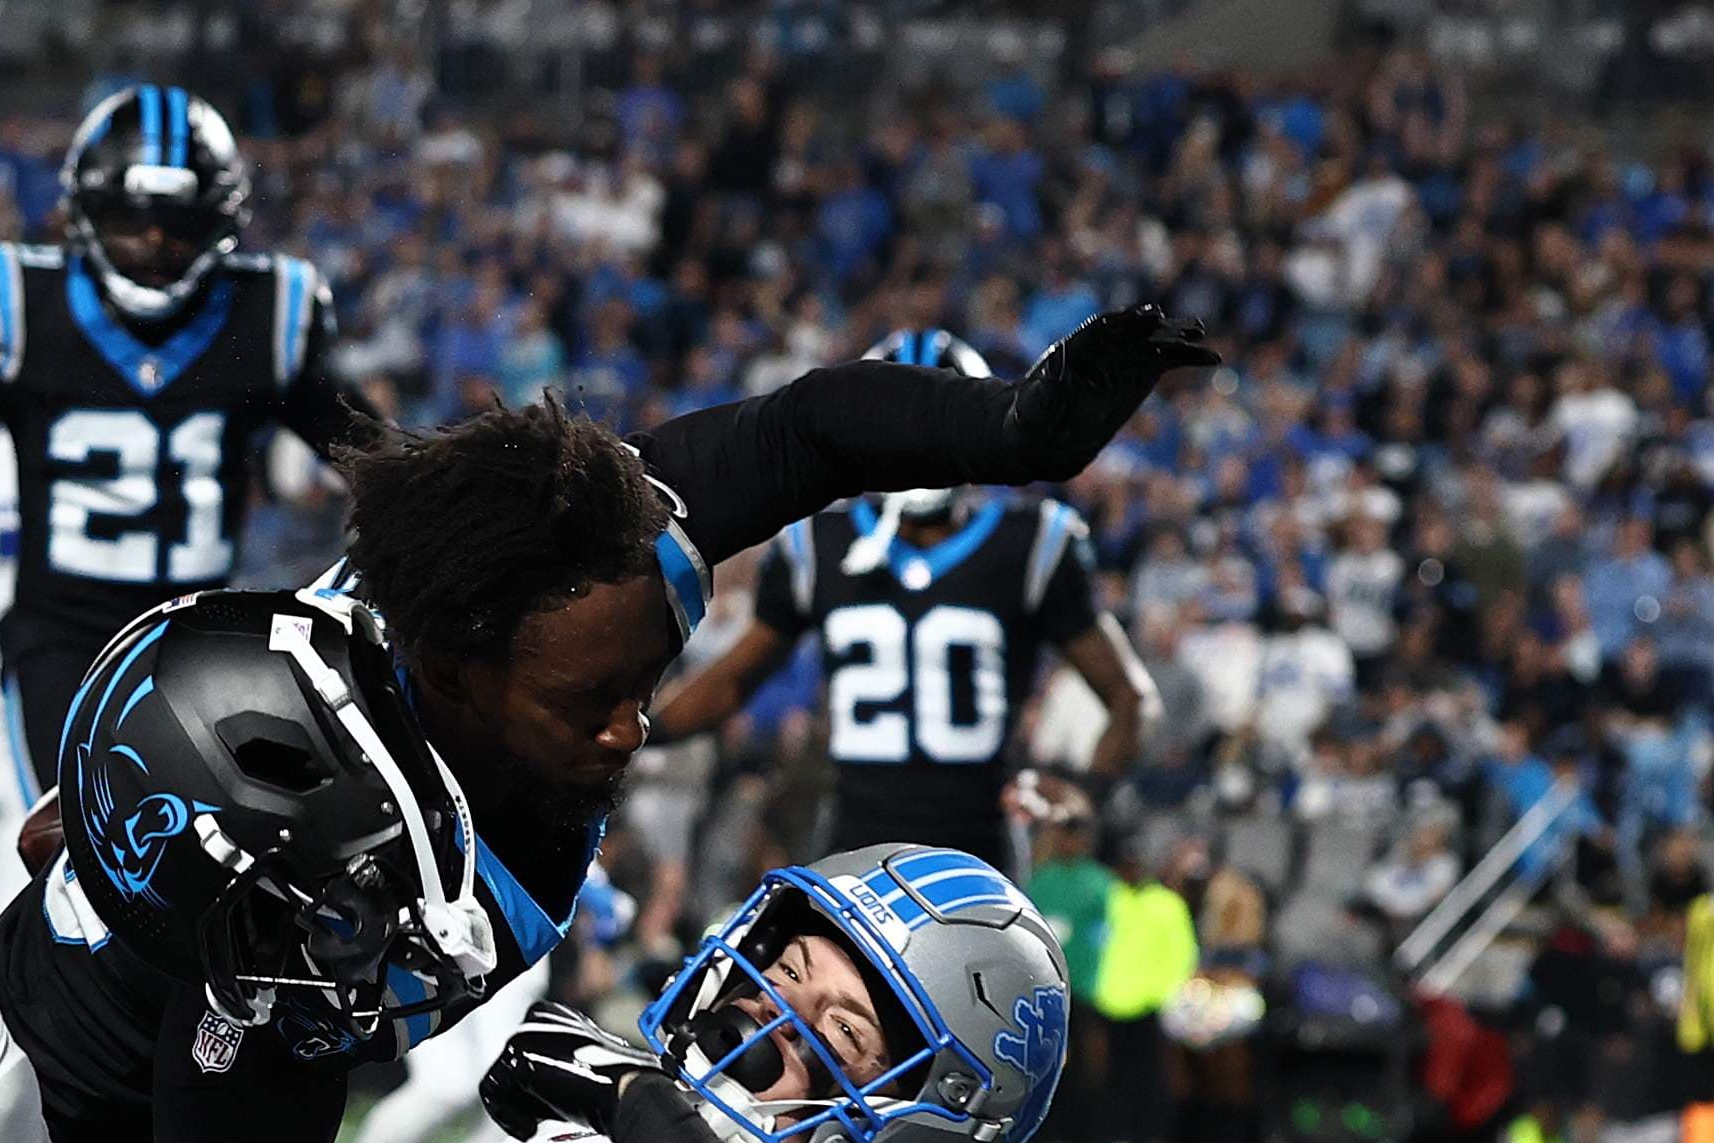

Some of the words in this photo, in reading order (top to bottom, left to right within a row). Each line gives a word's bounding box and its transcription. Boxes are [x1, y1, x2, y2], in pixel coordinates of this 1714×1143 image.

[48, 408, 234, 584] 21
[823, 603, 1007, 764] 20
[198, 1030, 230, 1066] NFL
